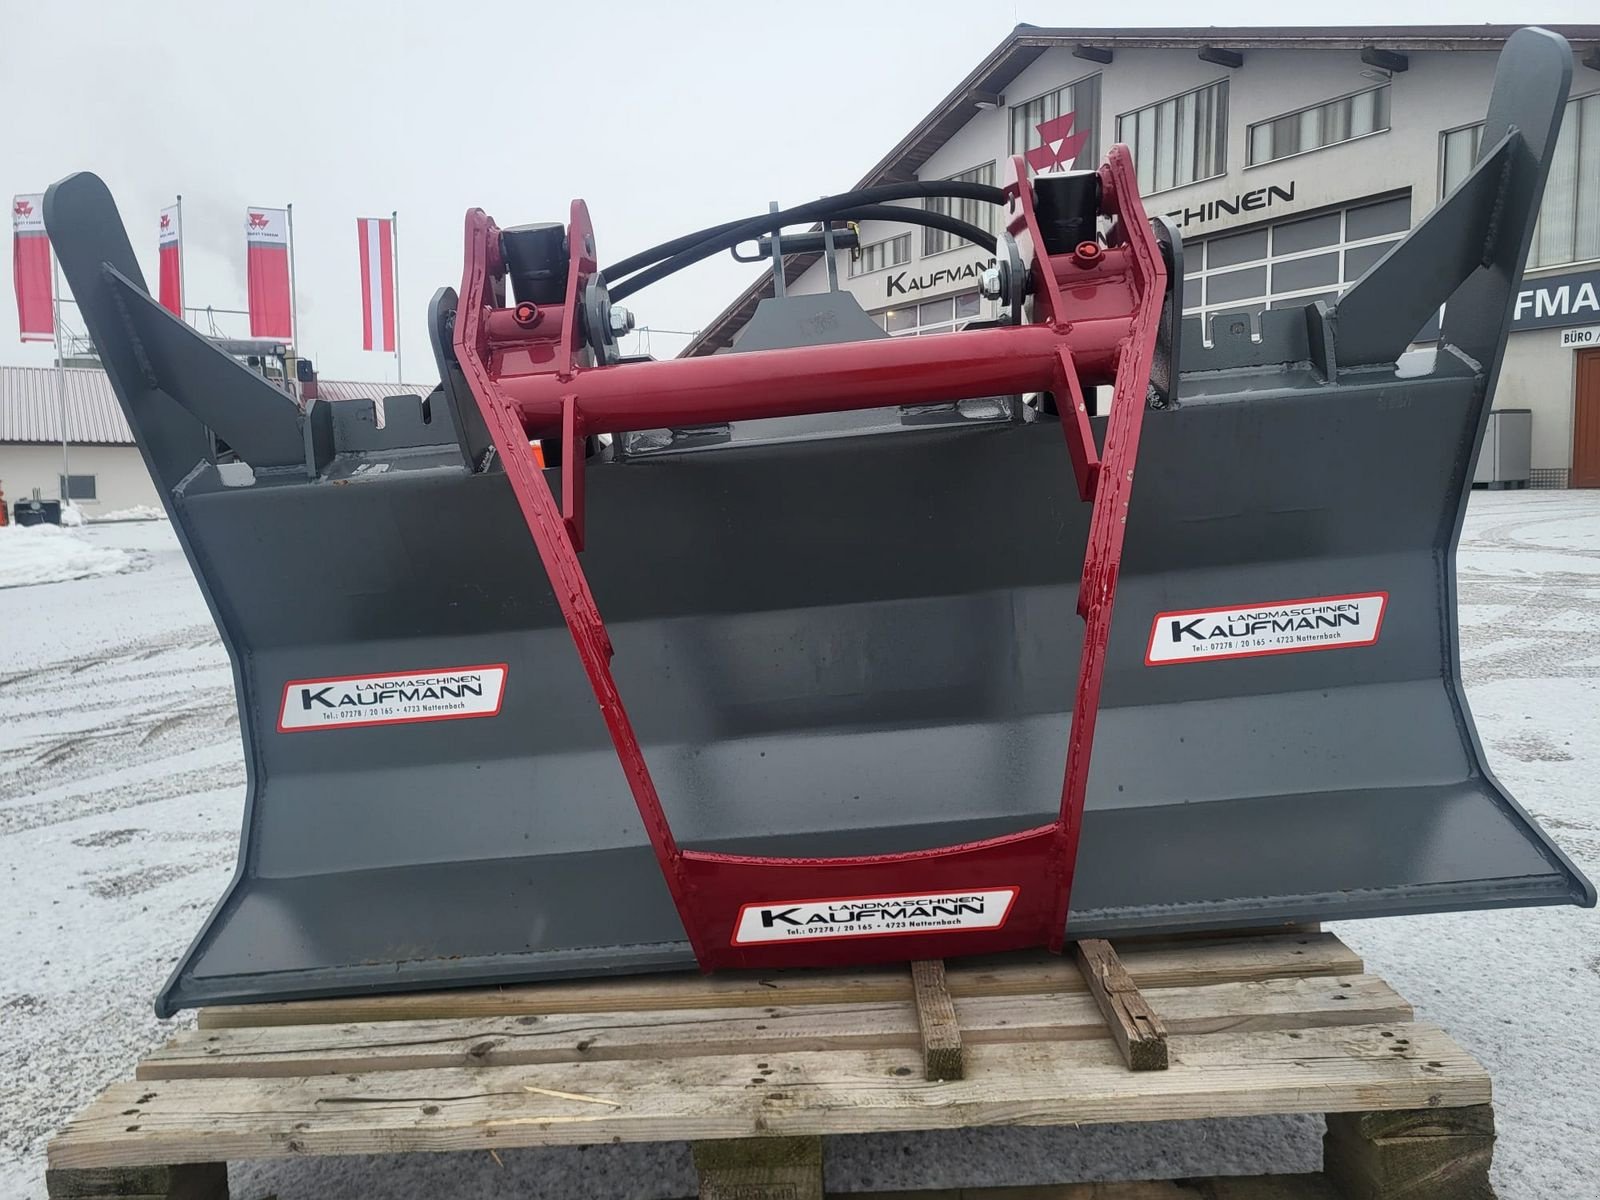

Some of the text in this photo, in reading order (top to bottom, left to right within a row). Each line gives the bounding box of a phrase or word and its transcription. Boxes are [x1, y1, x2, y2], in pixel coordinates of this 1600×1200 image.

[1564, 330, 1592, 344] BÜRO
[1228, 603, 1359, 622] LANDMASCHINEN
[1171, 612, 1360, 642] KAUFMANN
[1211, 641, 1232, 651] 07278
[1241, 639, 1250, 648] 20
[1253, 638, 1266, 647] 165
[1276, 635, 1294, 644] 4723
[1296, 631, 1341, 642] Natternbach
[356, 675, 481, 691] LANDMASCHINEN
[301, 683, 482, 710] KAUFMANN
[323, 712, 338, 720] Tel.:
[341, 709, 362, 719] 07278
[370, 708, 379, 716] 20
[381, 707, 393, 715] 165
[404, 705, 421, 713] 4723
[423, 701, 465, 711] Natternbach
[828, 896, 984, 911] LANDMASCHINEN
[761, 903, 984, 928] KAUFMANN
[808, 926, 834, 934] 07278
[886, 921, 906, 929] 4723
[909, 918, 962, 927] Natternbach
